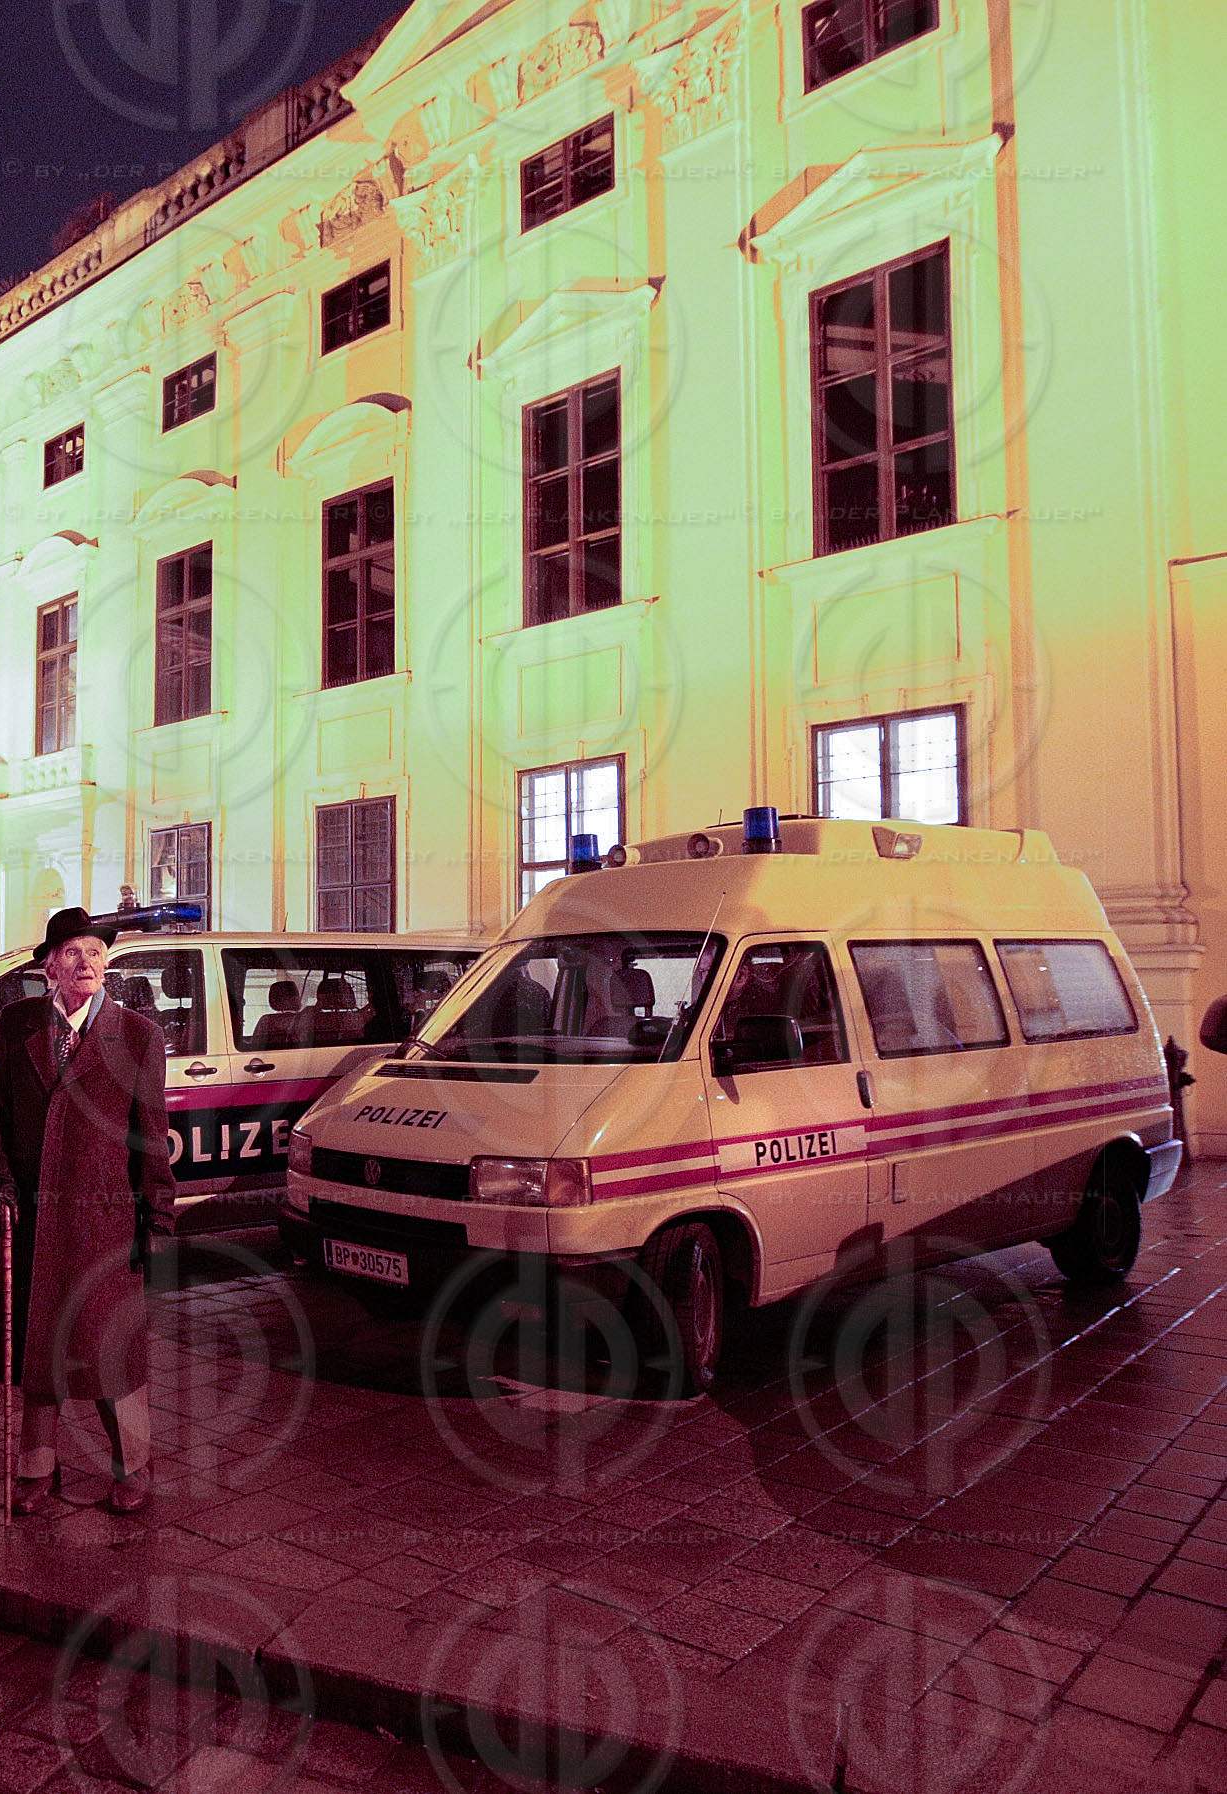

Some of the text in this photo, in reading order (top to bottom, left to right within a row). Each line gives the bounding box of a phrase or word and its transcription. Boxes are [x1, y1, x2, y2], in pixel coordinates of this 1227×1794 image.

[354, 1105, 448, 1129] POLIZEI
[167, 1120, 290, 1165] OLIZE
[755, 1131, 836, 1166] POLIZEI
[335, 1245, 401, 1278] BP 30575
